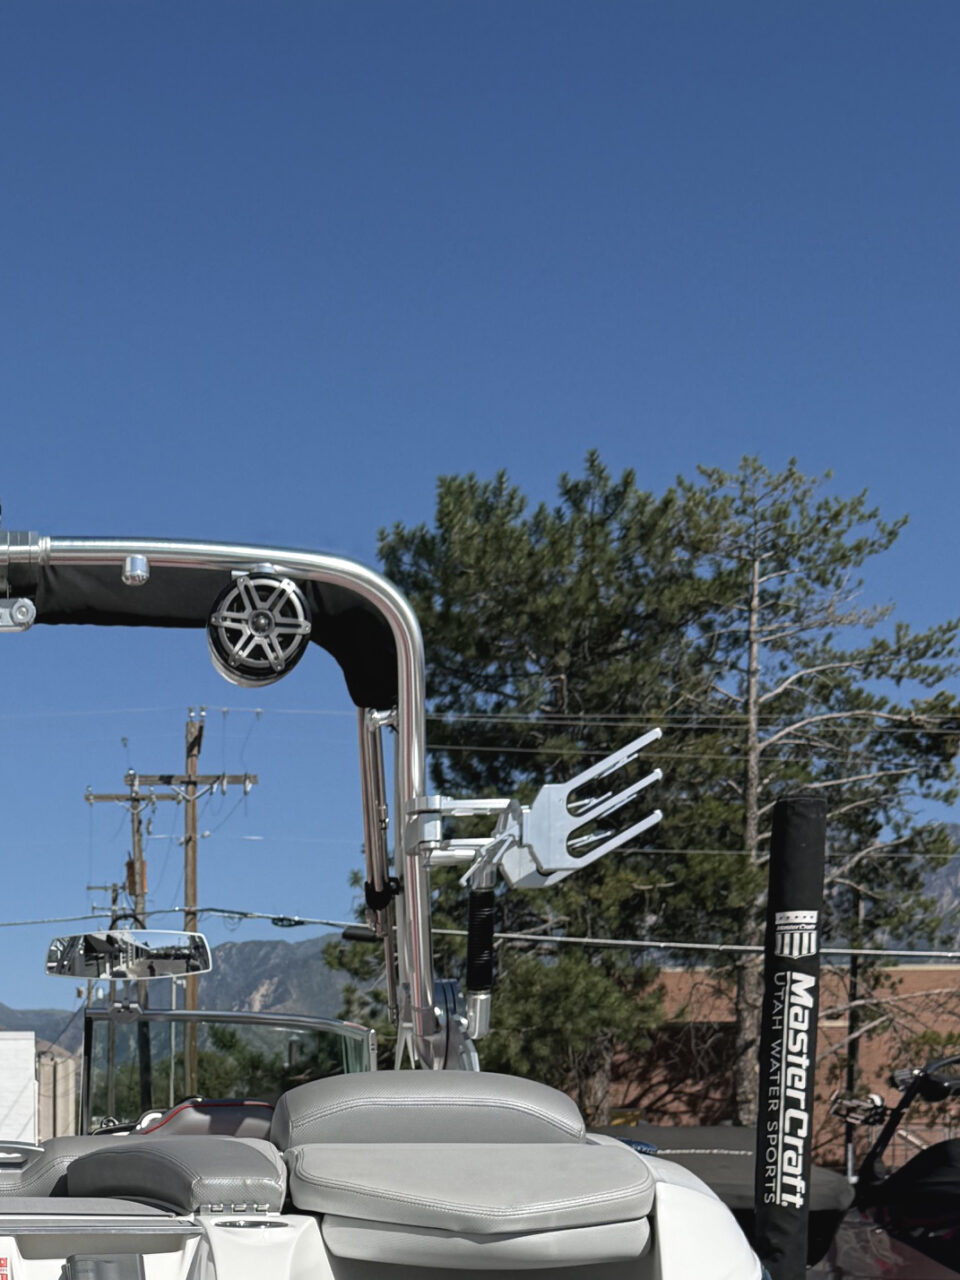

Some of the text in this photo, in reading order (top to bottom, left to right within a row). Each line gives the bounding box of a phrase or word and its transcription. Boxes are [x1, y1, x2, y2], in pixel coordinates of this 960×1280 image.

[763, 971, 786, 1204] UTAH WATER SPORTS
[781, 971, 816, 1208] MasterCraft
